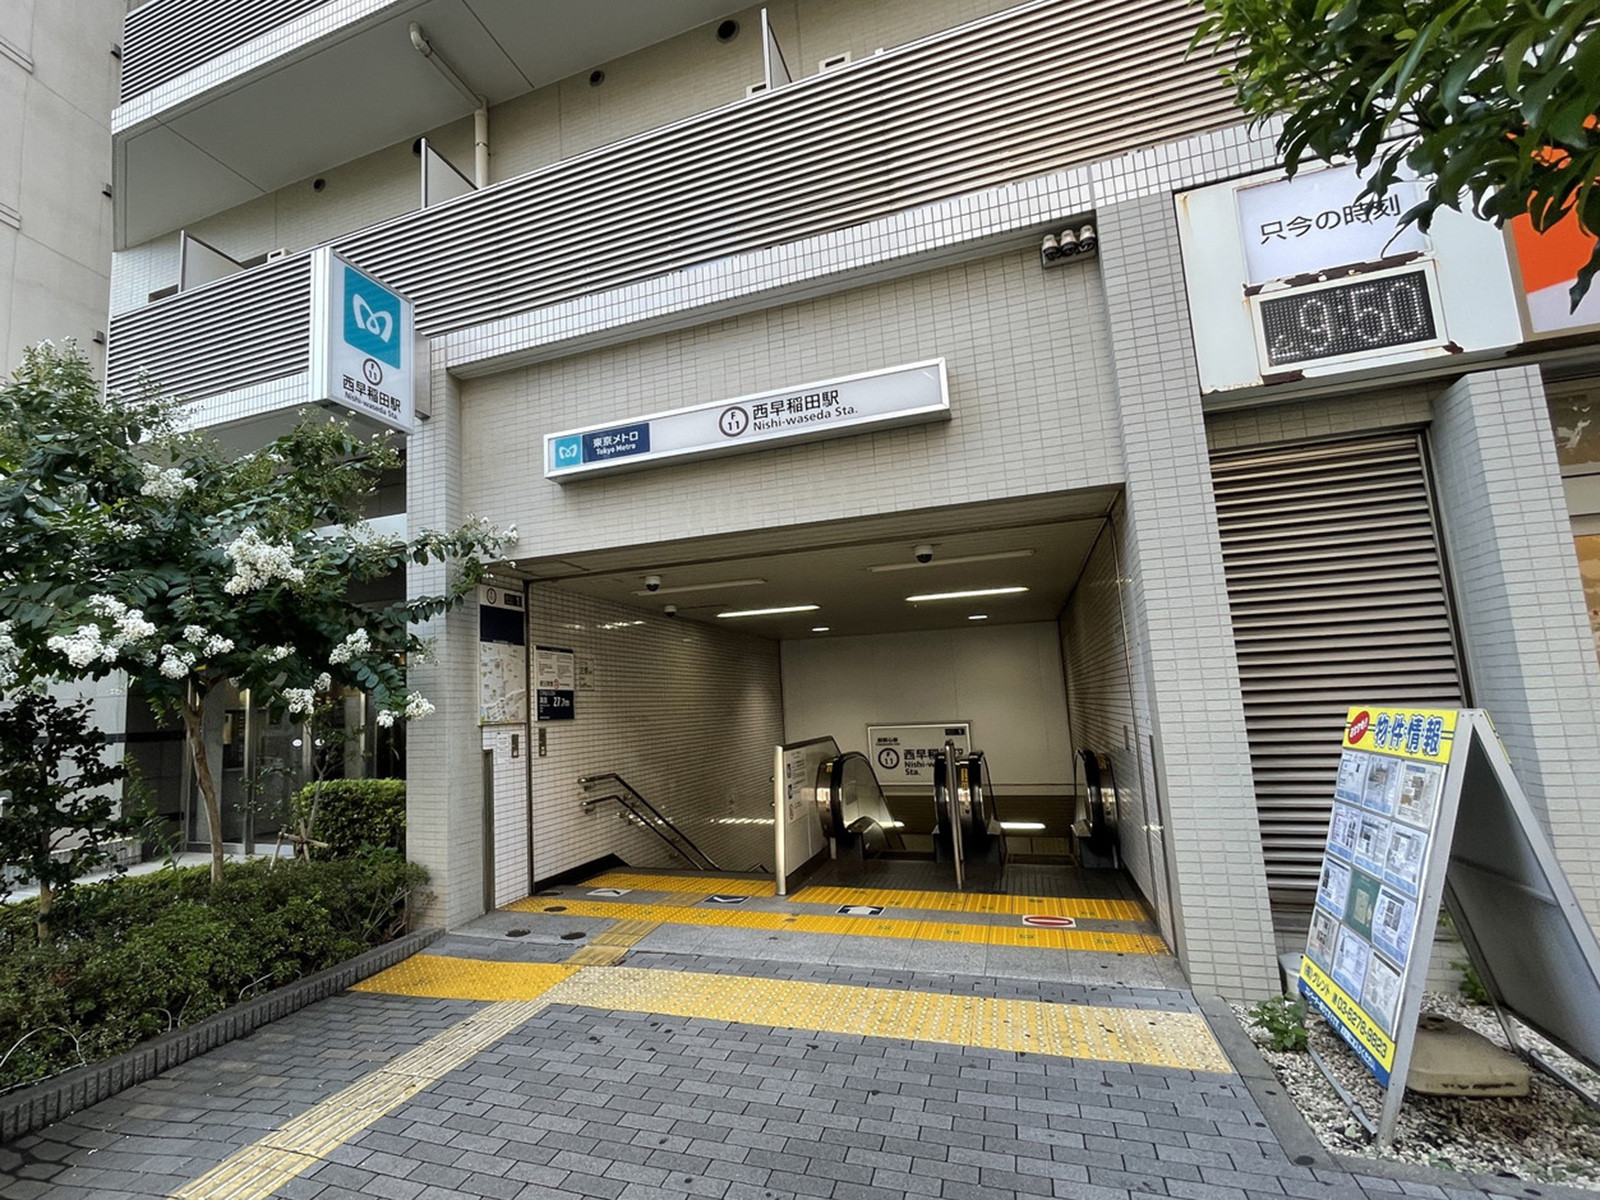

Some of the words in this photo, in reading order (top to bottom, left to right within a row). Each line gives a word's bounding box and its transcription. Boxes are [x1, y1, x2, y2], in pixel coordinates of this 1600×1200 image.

[1260, 193, 1402, 245] 只今の時刻
[343, 374, 401, 413] 西早稲田駅
[752, 389, 840, 420] 西早稲田駅
[727, 420, 740, 431] 11
[730, 411, 736, 420] F
[753, 409, 832, 431] Nishi-waseda
[835, 404, 859, 417] Sta.
[593, 431, 639, 448] 東京メトロ
[596, 446, 615, 456] Tokyo
[616, 443, 636, 453] Metro
[1375, 713, 1443, 756] 物件情報
[905, 768, 920, 776] Sta.
